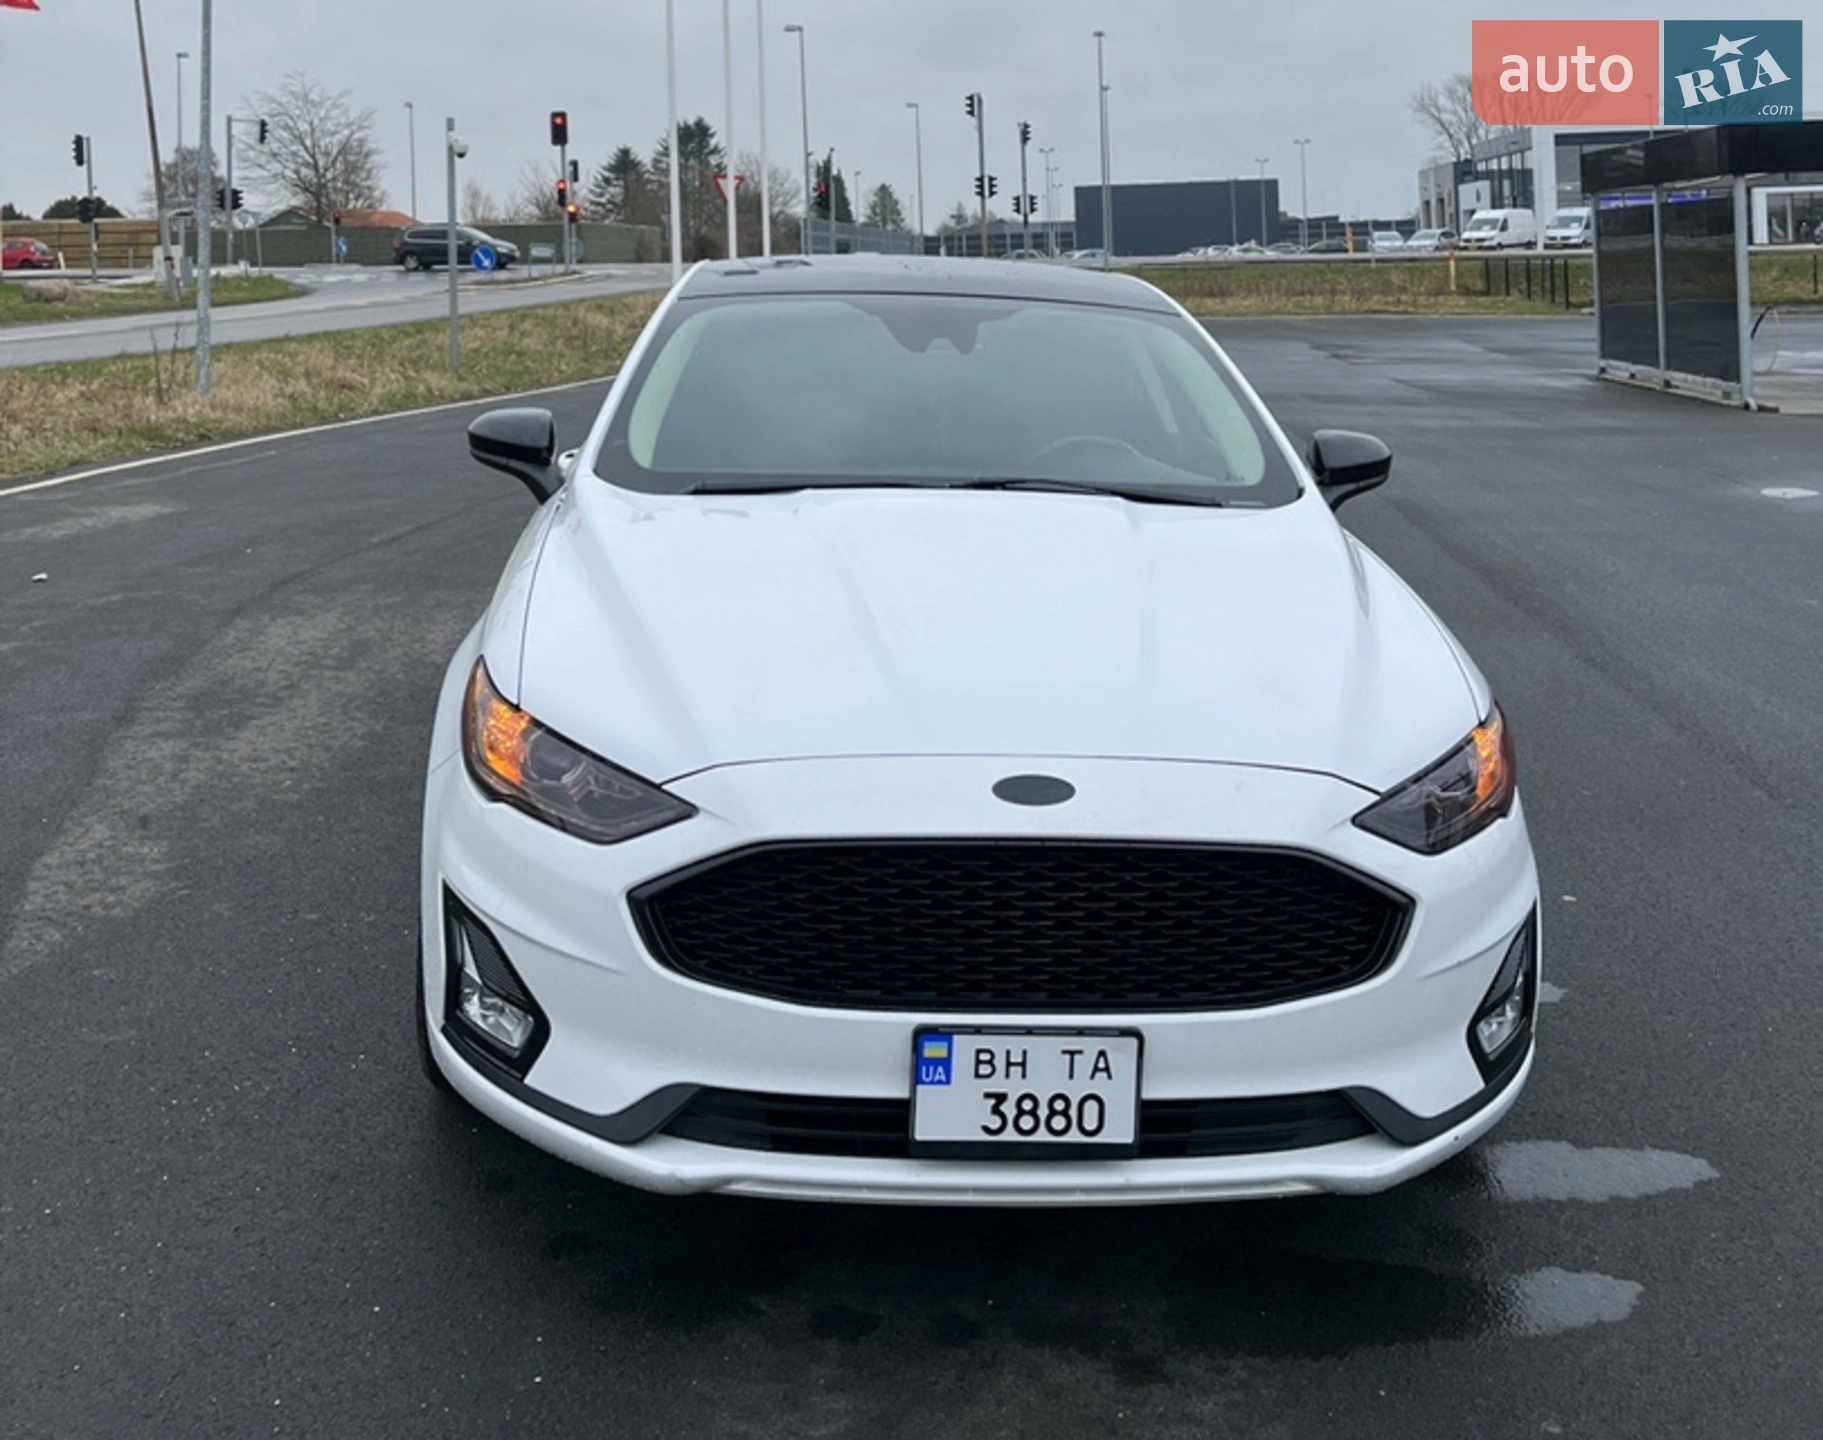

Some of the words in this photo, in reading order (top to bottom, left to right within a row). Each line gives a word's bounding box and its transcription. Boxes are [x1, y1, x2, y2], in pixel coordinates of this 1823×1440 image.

[921, 1065, 947, 1083] UA
[973, 1048, 1028, 1080] BH
[1060, 1049, 1113, 1081] TA
[980, 1091, 1106, 1138] 3880
